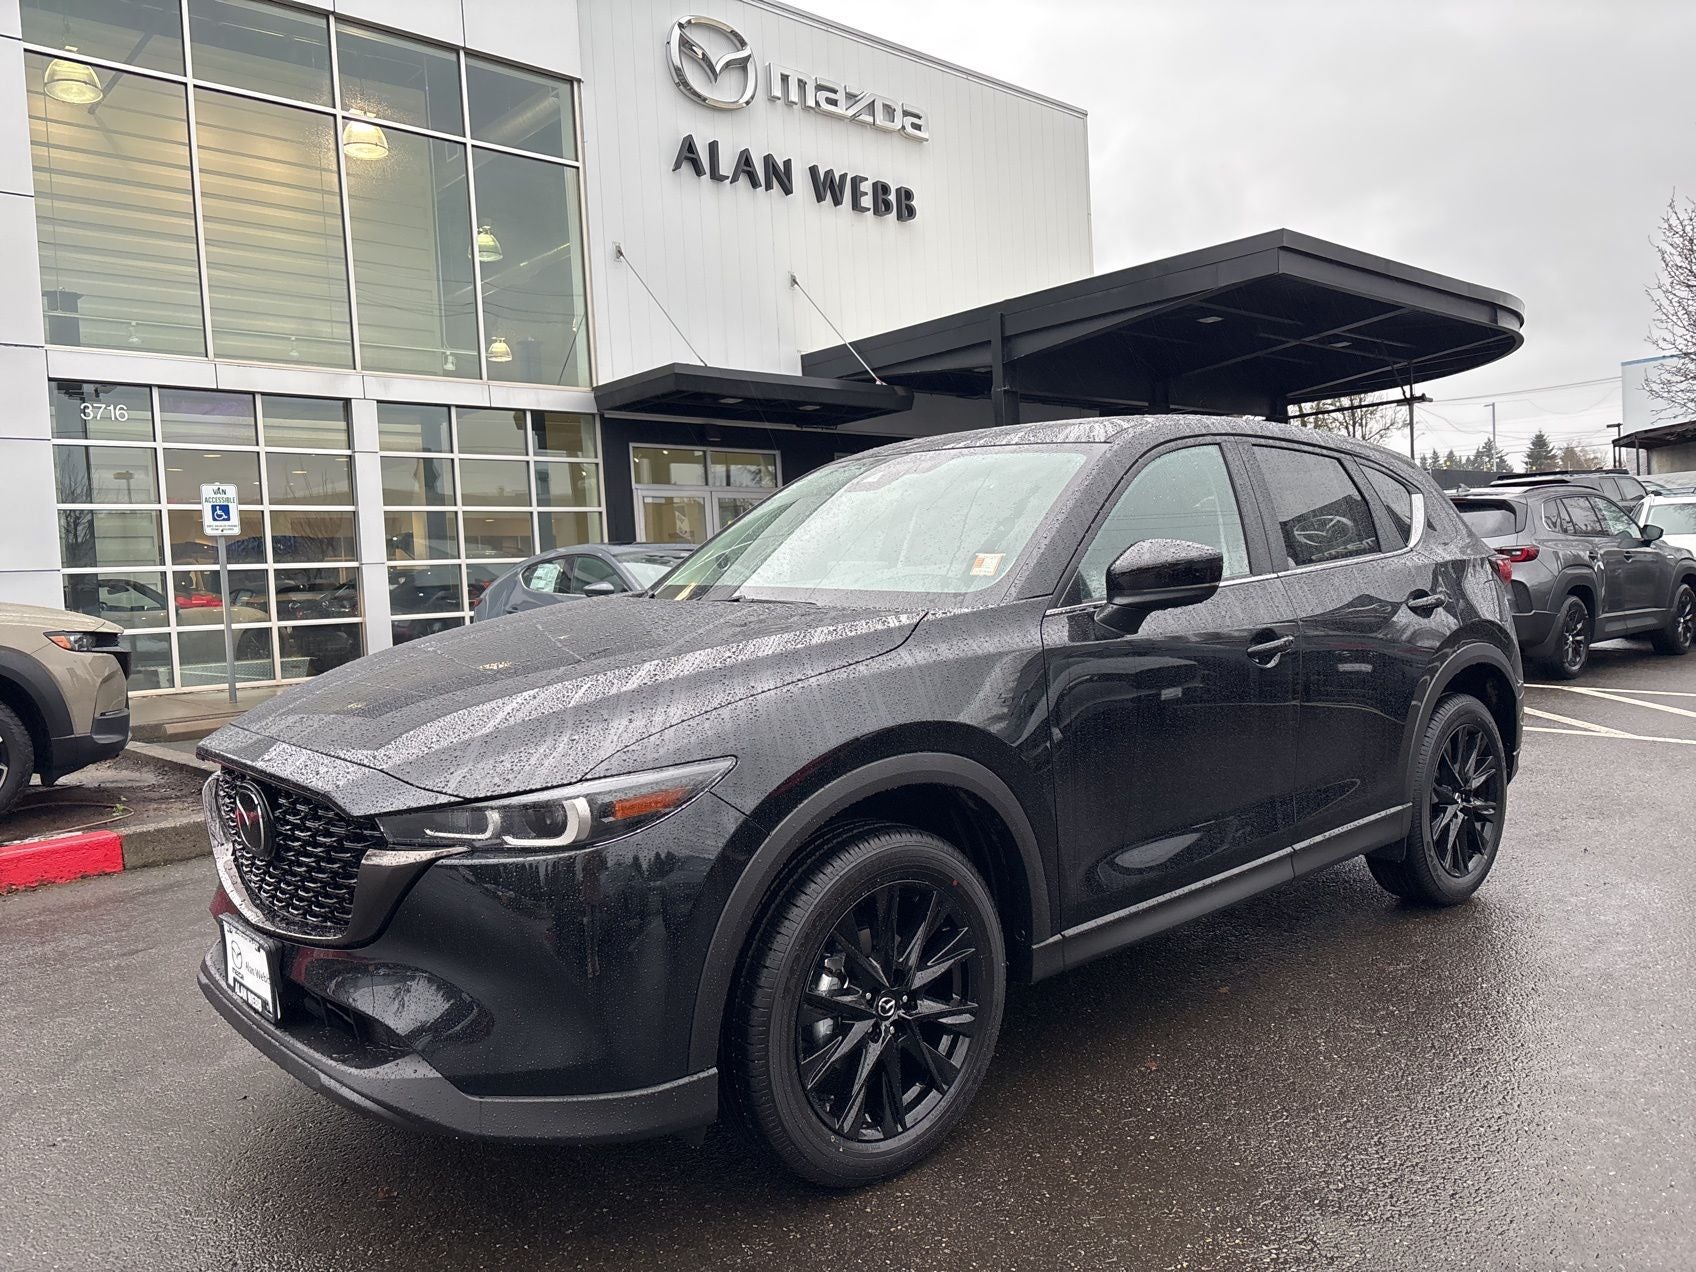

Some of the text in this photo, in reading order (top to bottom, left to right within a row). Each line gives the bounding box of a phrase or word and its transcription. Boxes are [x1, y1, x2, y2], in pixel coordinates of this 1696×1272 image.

[765, 62, 929, 142] mazda
[672, 133, 917, 222] ALAN WEBB
[80, 402, 128, 421] 3716
[204, 496, 236, 504] ACCESSIBLE
[212, 487, 227, 496] VAN
